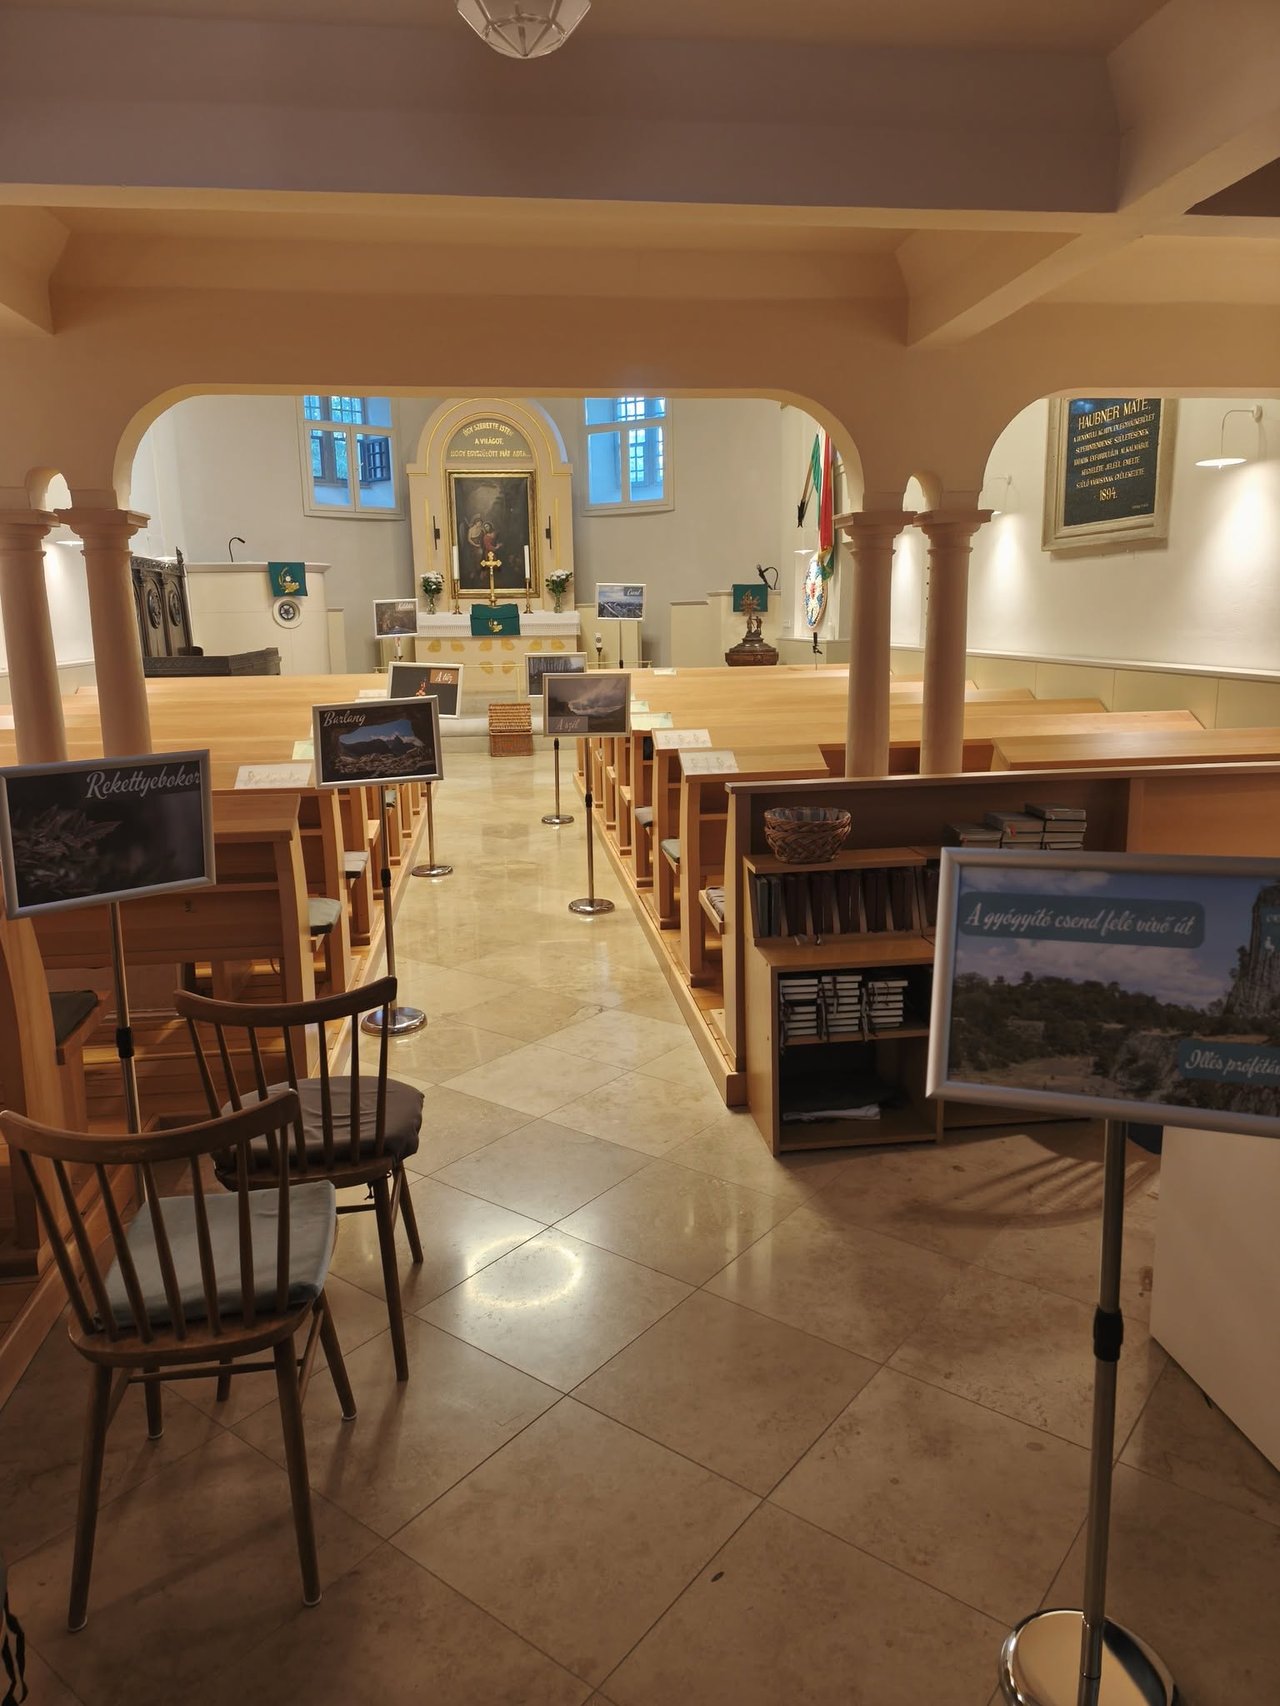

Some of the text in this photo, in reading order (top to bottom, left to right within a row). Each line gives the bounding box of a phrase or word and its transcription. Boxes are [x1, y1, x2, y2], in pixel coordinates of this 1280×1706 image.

[1078, 405, 1120, 431] HAUBNER
[323, 710, 366, 727] Barlang
[85, 765, 200, 800] Rekettyebokor
[965, 902, 1196, 937] A gyógyító csend felé vivő út
[1184, 1049, 1223, 1071] Illés
